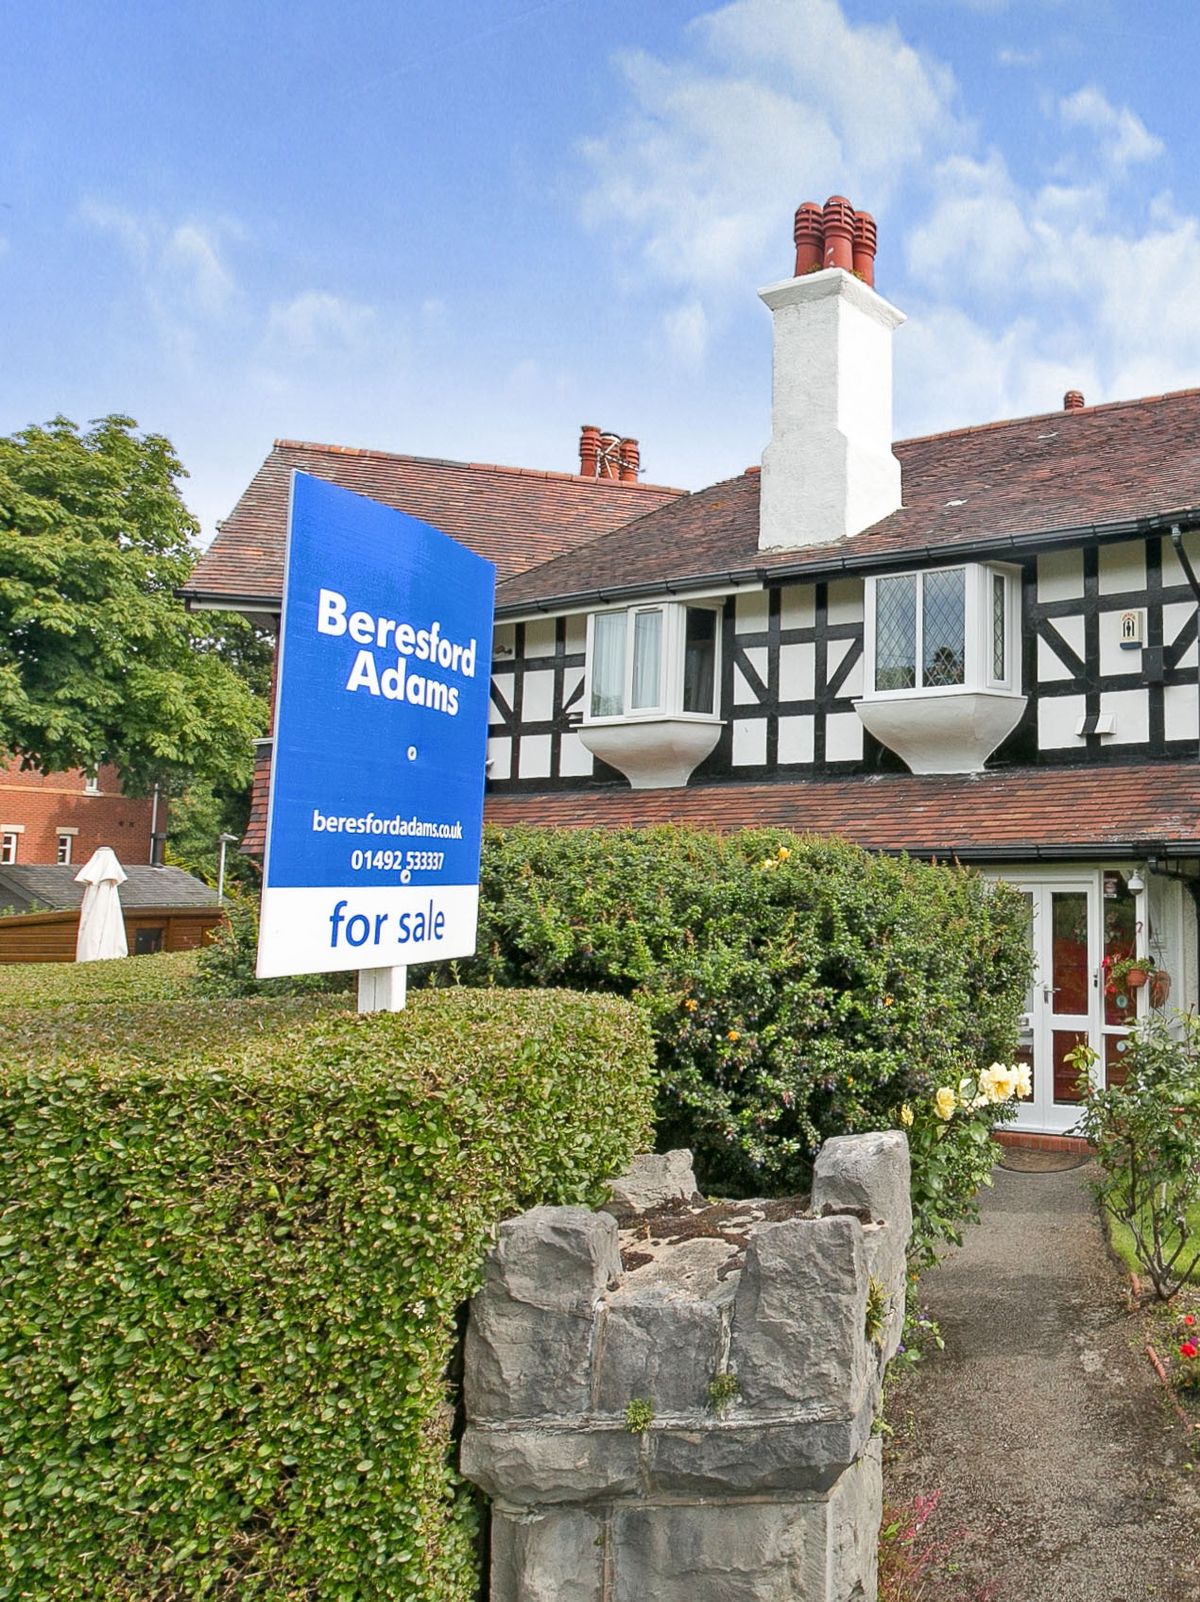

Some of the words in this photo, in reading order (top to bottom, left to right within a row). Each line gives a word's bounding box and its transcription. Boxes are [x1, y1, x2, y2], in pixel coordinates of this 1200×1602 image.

[317, 588, 476, 678] Beresford
[346, 649, 459, 716] Adams
[312, 809, 463, 840] beresfordadams.co.uk
[351, 849, 402, 871] 01492
[405, 852, 445, 872] 533337
[329, 900, 388, 948] for
[397, 899, 446, 944] sale
